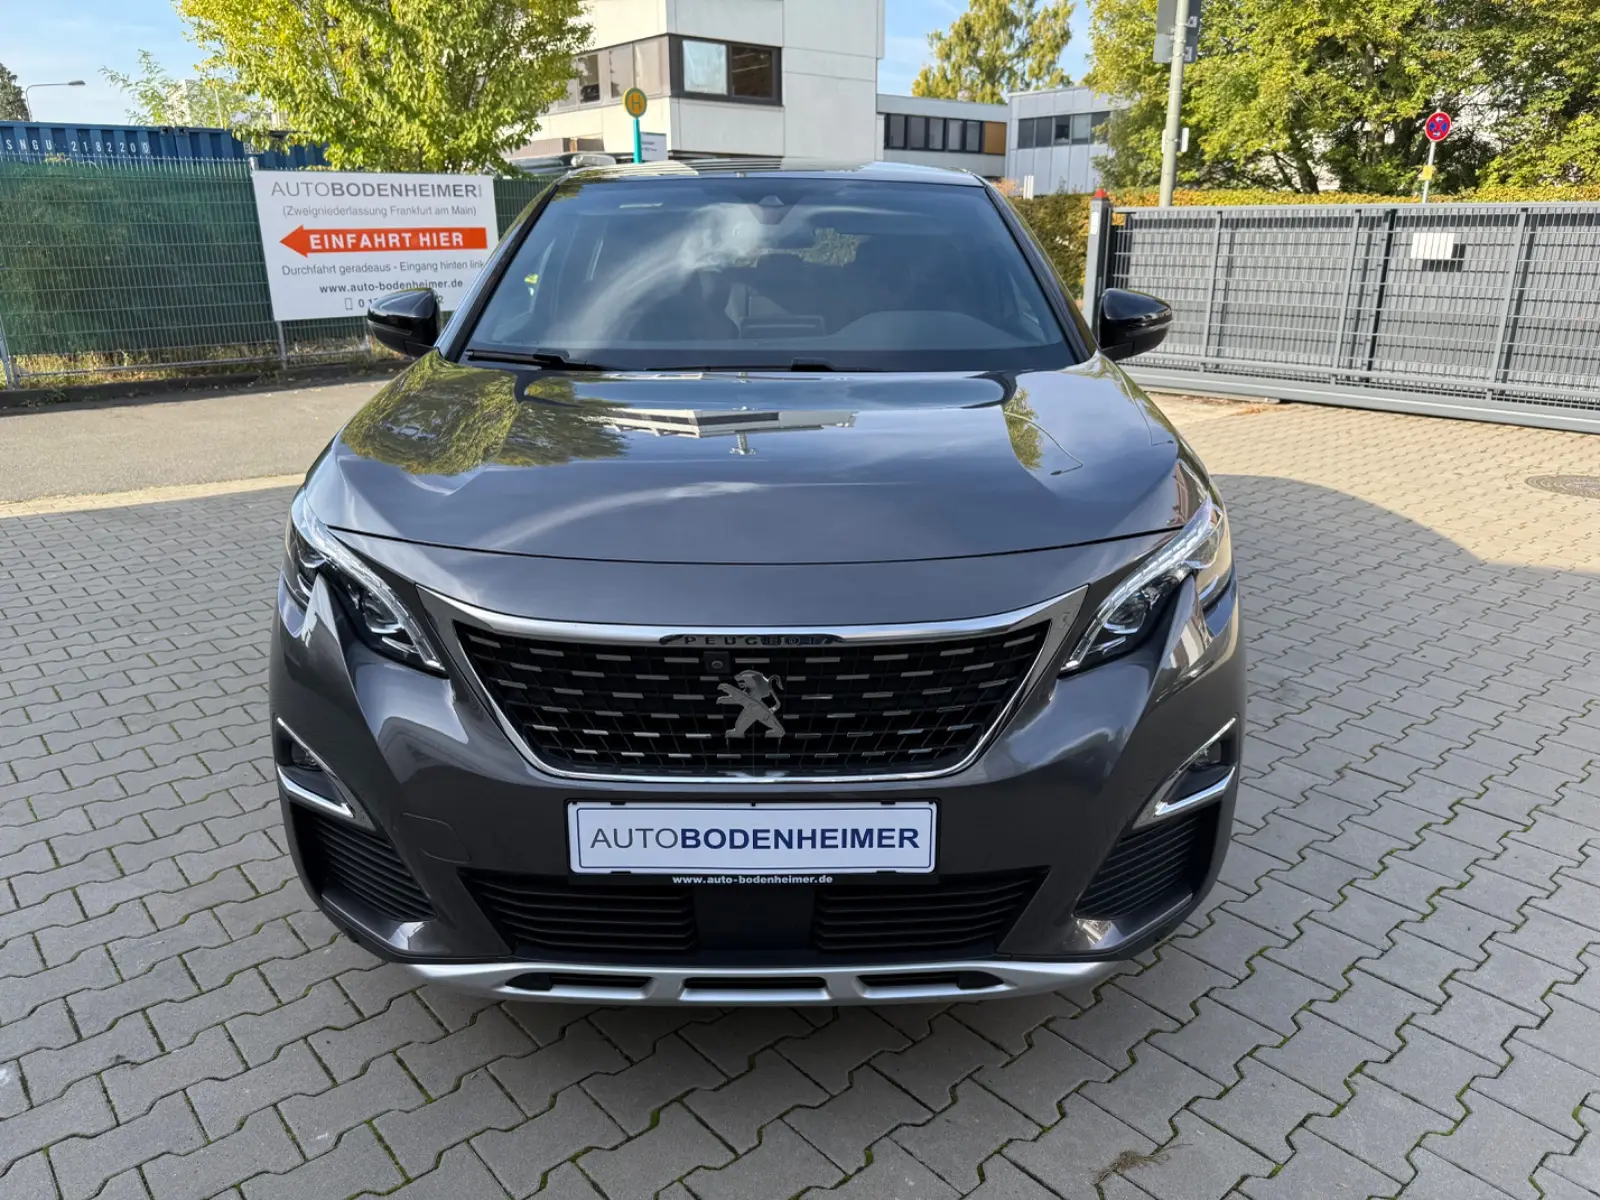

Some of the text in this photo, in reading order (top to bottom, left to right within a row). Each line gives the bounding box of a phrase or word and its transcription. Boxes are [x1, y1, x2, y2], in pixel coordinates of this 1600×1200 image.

[631, 95, 643, 111] H
[5, 138, 53, 151] SNGU
[271, 181, 477, 197] AUTOBODENHEIMER
[283, 205, 477, 219] (Zweigniederlassung Frankfurt am Main)
[309, 231, 464, 250] EINFAHRT HIER
[281, 264, 337, 276] Durchfahrt
[339, 262, 391, 275] geradeaus
[399, 260, 438, 273] Eingang
[440, 260, 468, 269] hinten
[470, 260, 485, 268] link
[319, 279, 463, 293] www.auto-bodenheimer.de
[684, 635, 819, 645] PEUGO
[590, 828, 920, 849] AUTOBODENHEIMER
[672, 875, 833, 885] www.auto-bodenheimer.de
